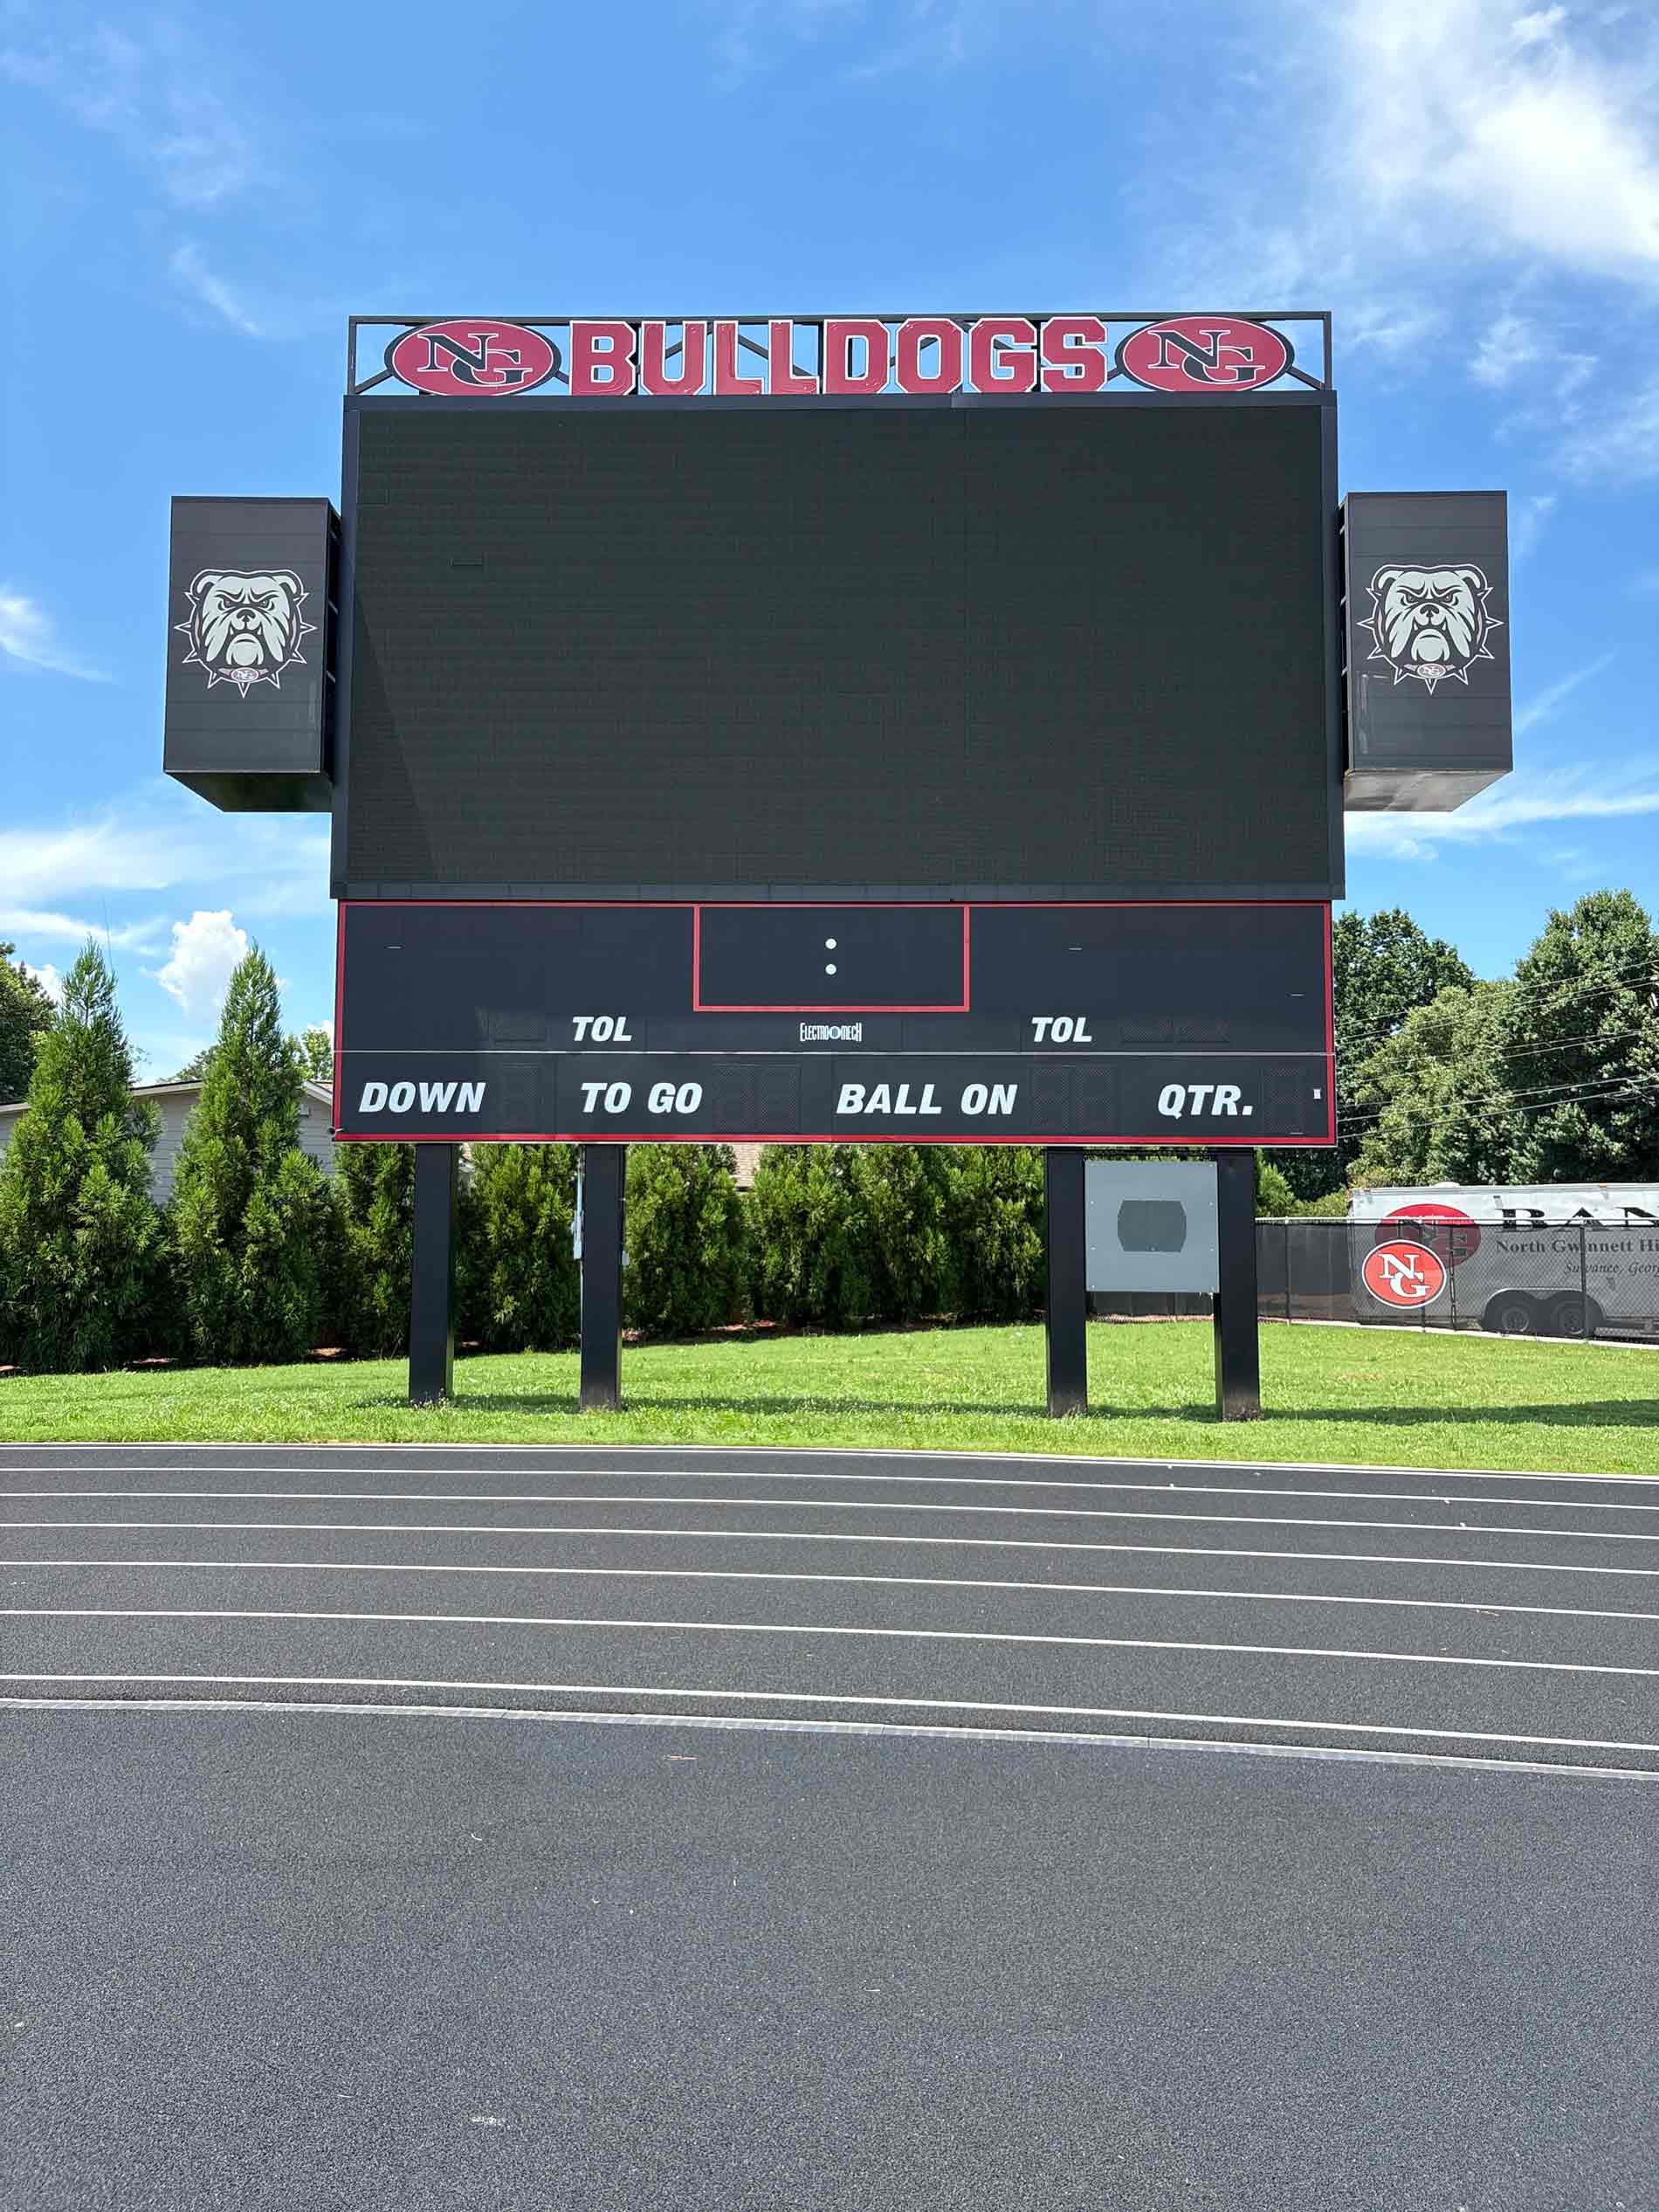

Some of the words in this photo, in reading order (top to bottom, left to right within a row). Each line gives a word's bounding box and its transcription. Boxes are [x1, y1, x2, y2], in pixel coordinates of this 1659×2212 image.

[416, 333, 533, 387] NG
[569, 316, 1108, 396] BULLDOGS
[1147, 329, 1266, 385] NG
[572, 1016, 632, 1042] TOL
[1031, 1016, 1092, 1043] TOL
[358, 1081, 486, 1113] DOWN
[581, 1081, 632, 1113] TO
[647, 1082, 703, 1114] GO
[836, 1083, 943, 1114] BALL
[960, 1083, 1018, 1115] ON
[1158, 1084, 1254, 1120] QTR.
[1496, 1239, 1545, 1252] North
[1552, 1238, 1635, 1253] Gwnnett
[1378, 1252, 1432, 1299] NG
